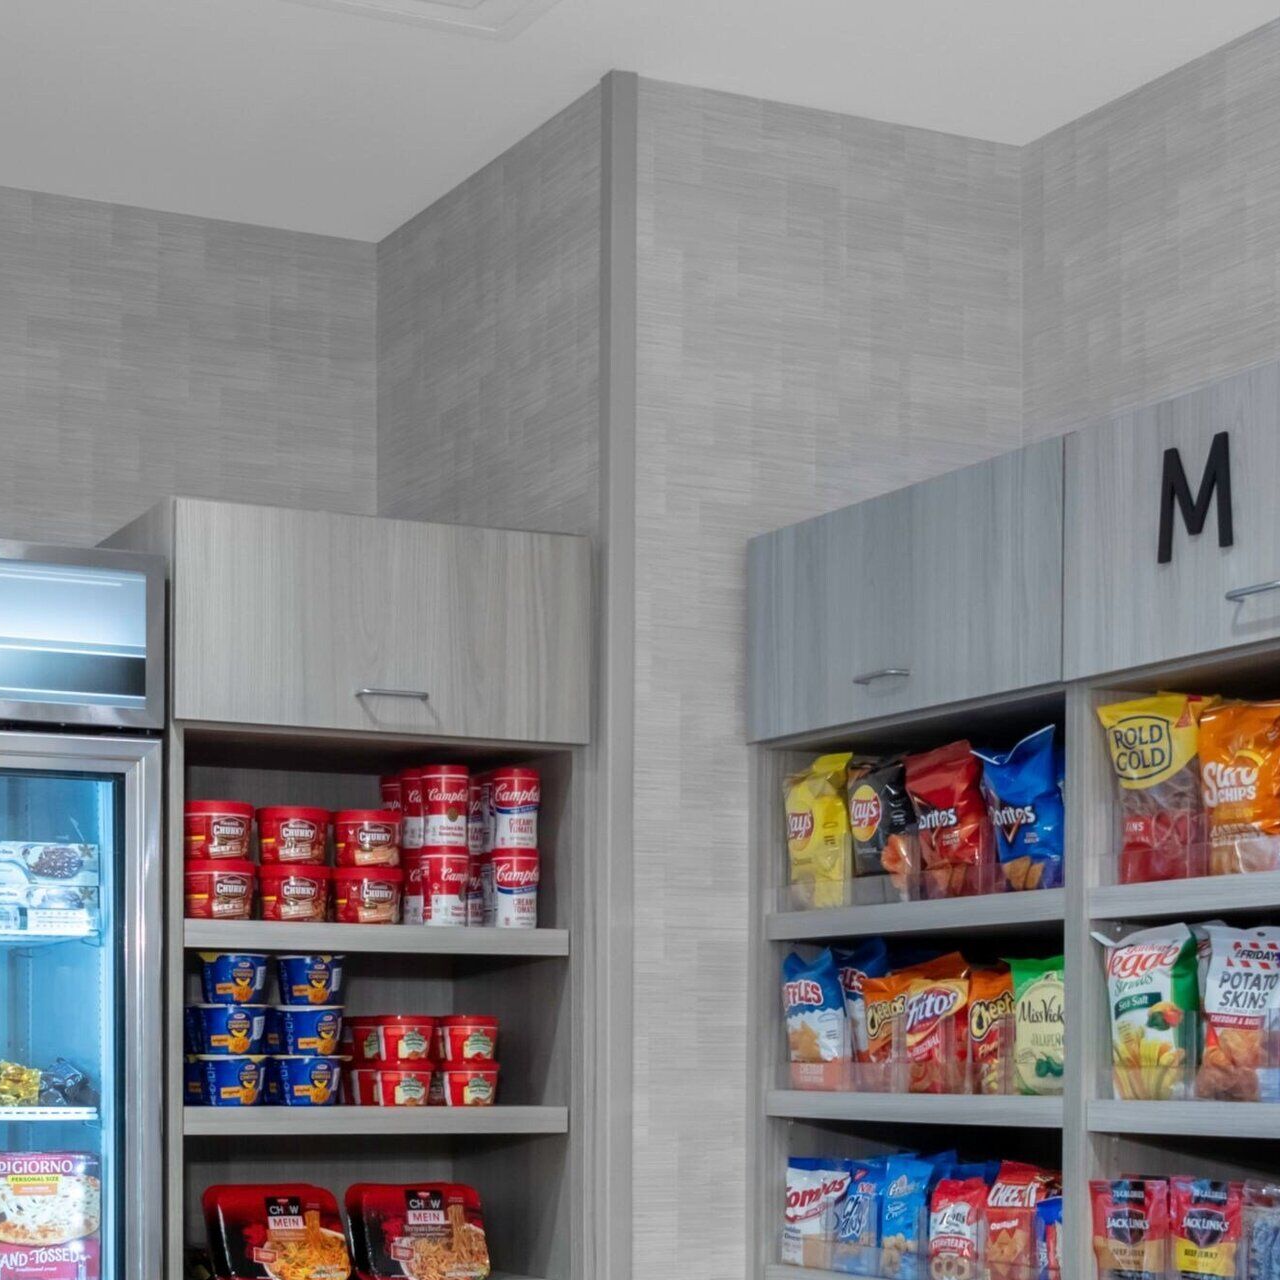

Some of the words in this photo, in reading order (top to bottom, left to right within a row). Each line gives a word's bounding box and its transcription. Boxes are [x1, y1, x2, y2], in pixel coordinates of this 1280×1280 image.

[1114, 724, 1163, 748] ROLD
[1116, 747, 1166, 771] GOLD
[1219, 786, 1256, 803] CHIPS
[213, 825, 244, 838] CHUNKY
[282, 828, 315, 840] CHUNKY
[216, 883, 247, 896] CHUNKY
[284, 885, 316, 897] CHUNKY
[1219, 971, 1279, 991] POTATO
[1219, 990, 1269, 1010] SKINS
[273, 1217, 300, 1228] MEIN
[412, 1212, 441, 1222] MEIN
